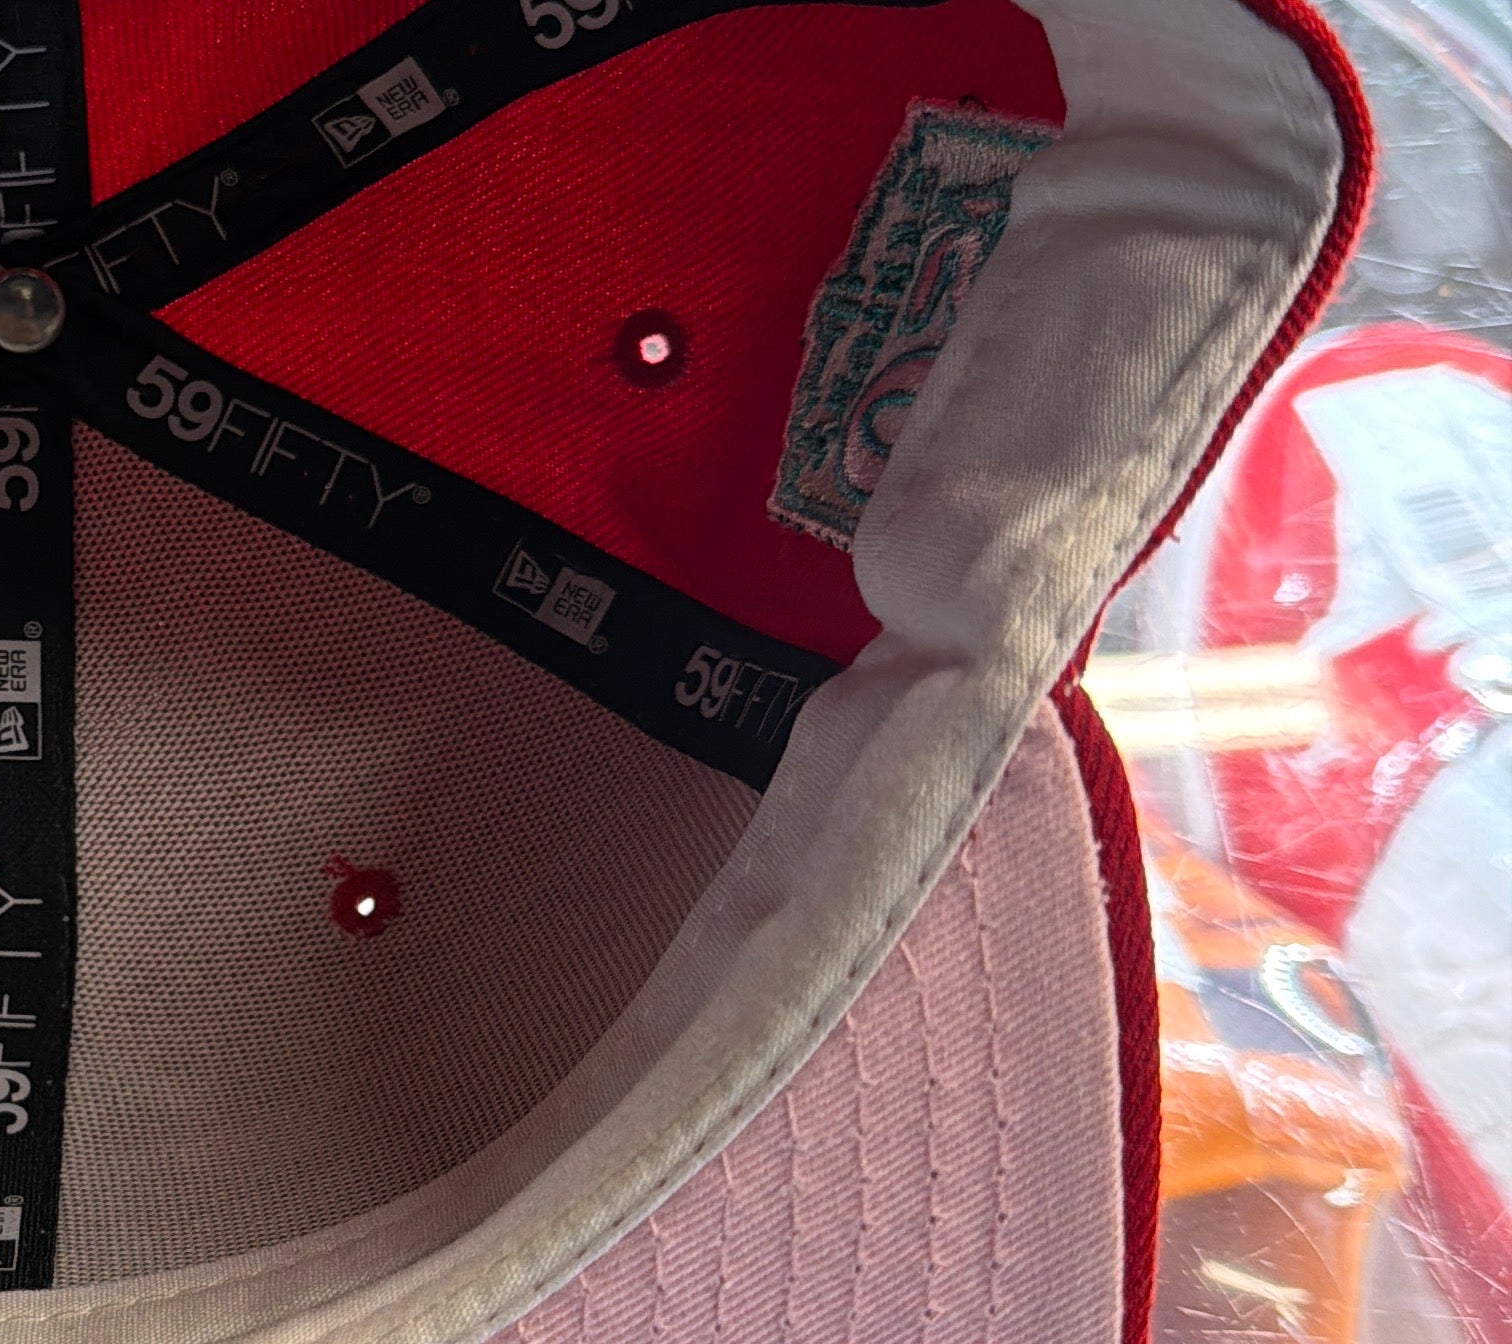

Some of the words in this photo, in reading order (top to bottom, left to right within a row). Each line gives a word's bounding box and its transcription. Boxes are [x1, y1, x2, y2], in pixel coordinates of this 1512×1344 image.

[375, 75, 418, 108] NEW
[387, 90, 430, 120] ERA
[562, 581, 603, 612] NEW
[553, 597, 592, 629] ERA
[10, 649, 27, 692] ERA
